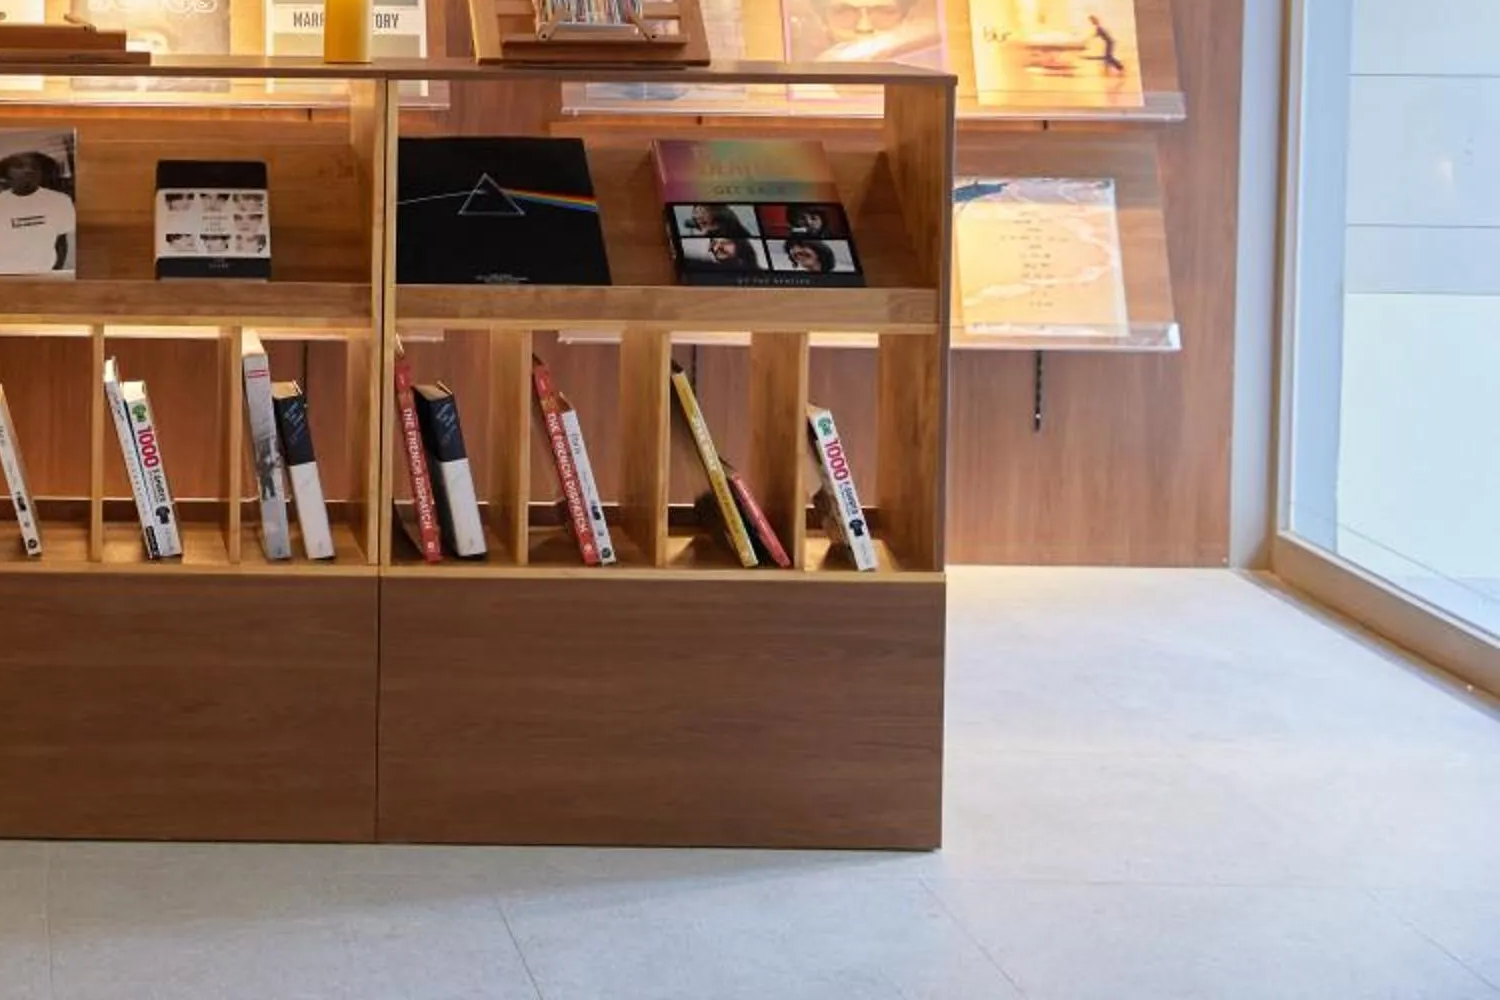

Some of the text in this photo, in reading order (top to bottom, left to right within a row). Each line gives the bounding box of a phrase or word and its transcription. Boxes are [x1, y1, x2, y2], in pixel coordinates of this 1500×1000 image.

[372, 12, 400, 29] ORY
[402, 407, 415, 429] THE
[137, 426, 160, 468] 1000
[824, 438, 849, 480] 1000
